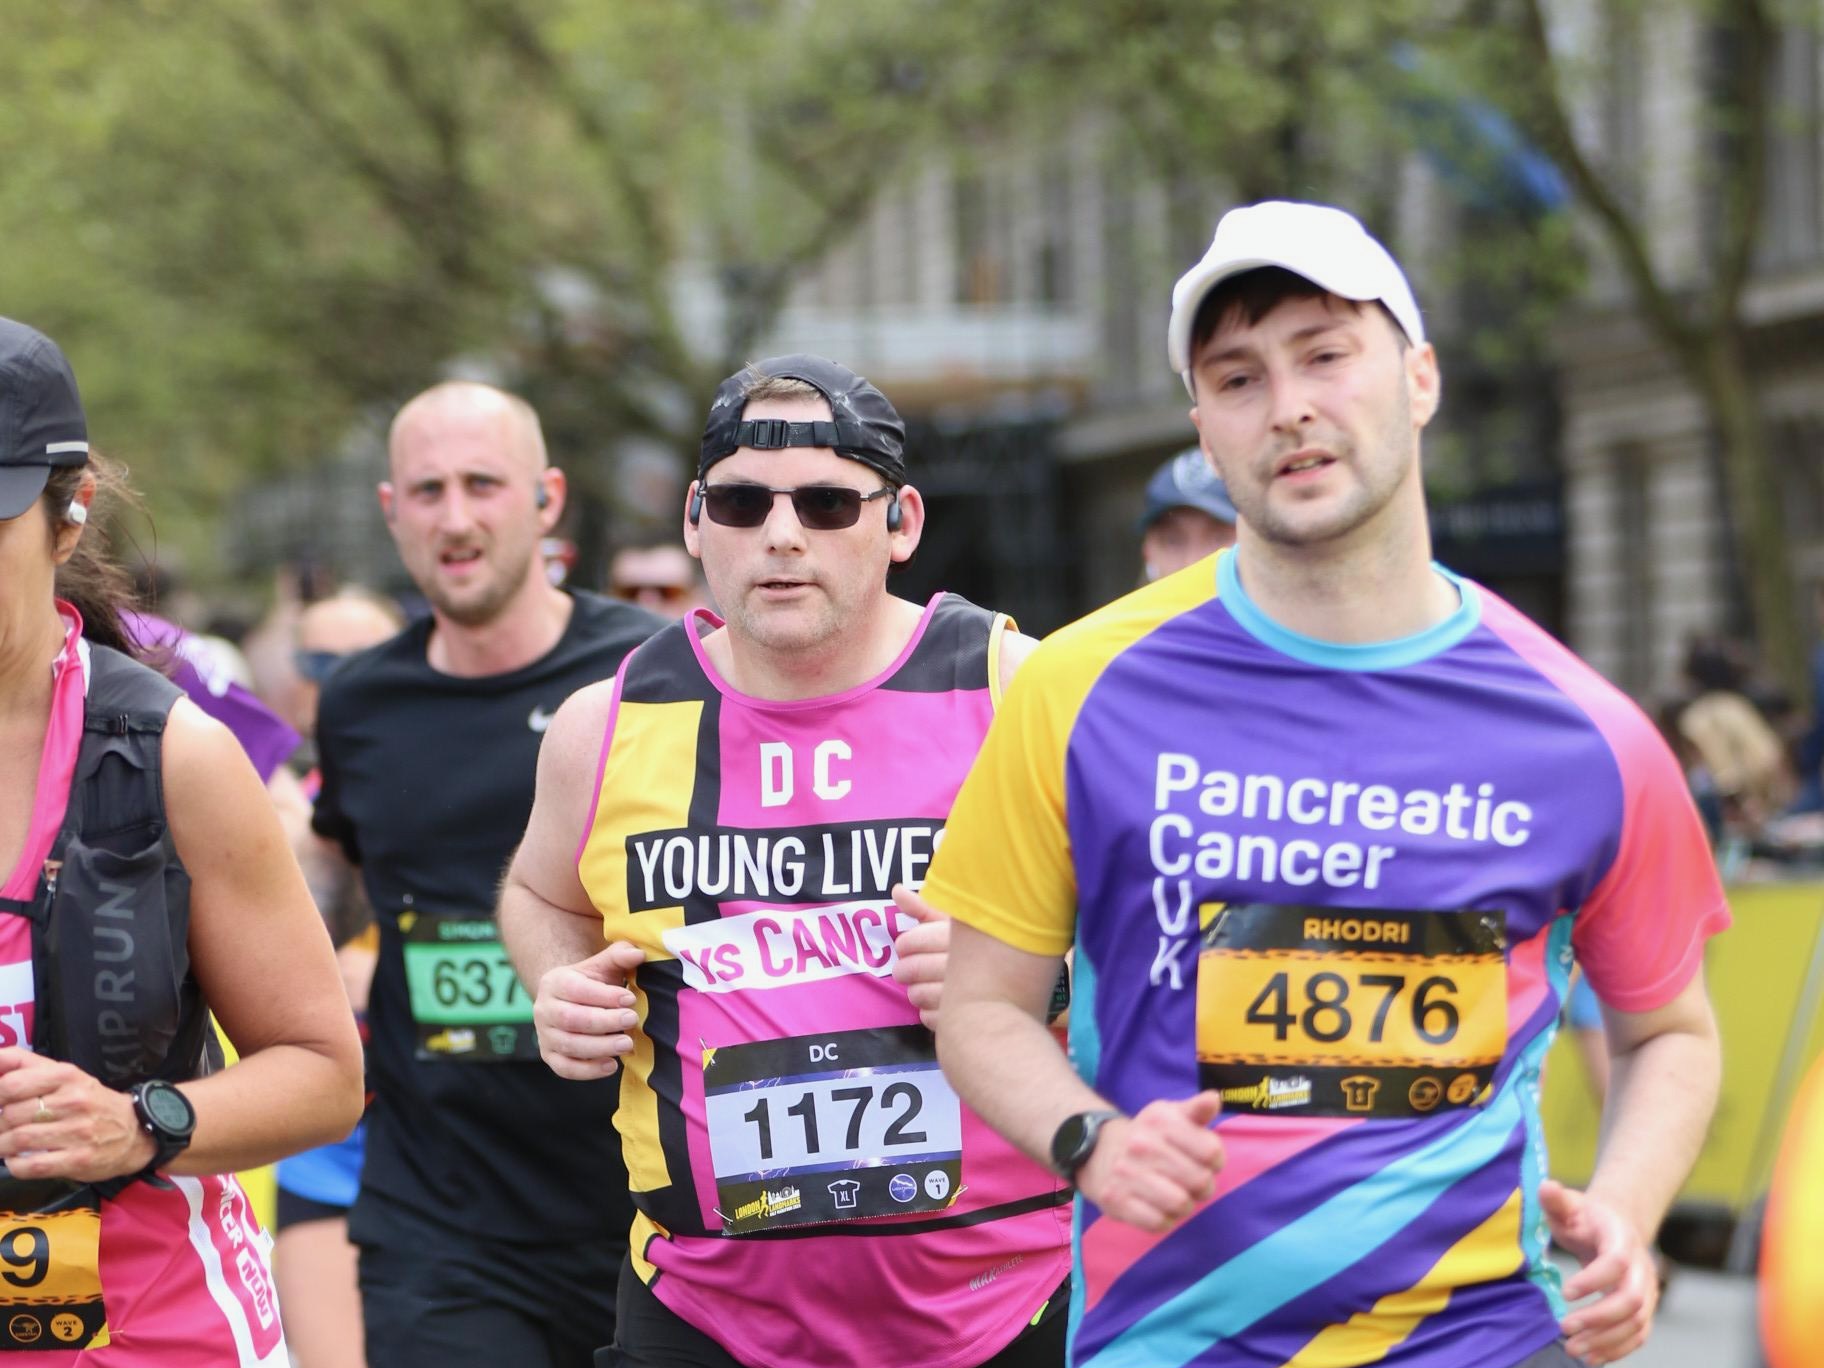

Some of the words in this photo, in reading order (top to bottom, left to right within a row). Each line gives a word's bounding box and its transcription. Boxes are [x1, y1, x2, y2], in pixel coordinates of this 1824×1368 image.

[1154, 752, 1533, 847] Pancreatic
[635, 836, 806, 900] YOUNG
[1149, 813, 1396, 890] Cancer
[1303, 918, 1410, 944] RHODRI
[1245, 972, 1460, 1046] 4876
[808, 1042, 839, 1063] DC
[743, 1081, 928, 1161] 1172
[735, 1200, 761, 1220] LONDON
[840, 1190, 850, 1202] XL
[935, 1184, 941, 1195] 1
[242, 1259, 269, 1318] NOW
[63, 1326, 73, 1337] 2
